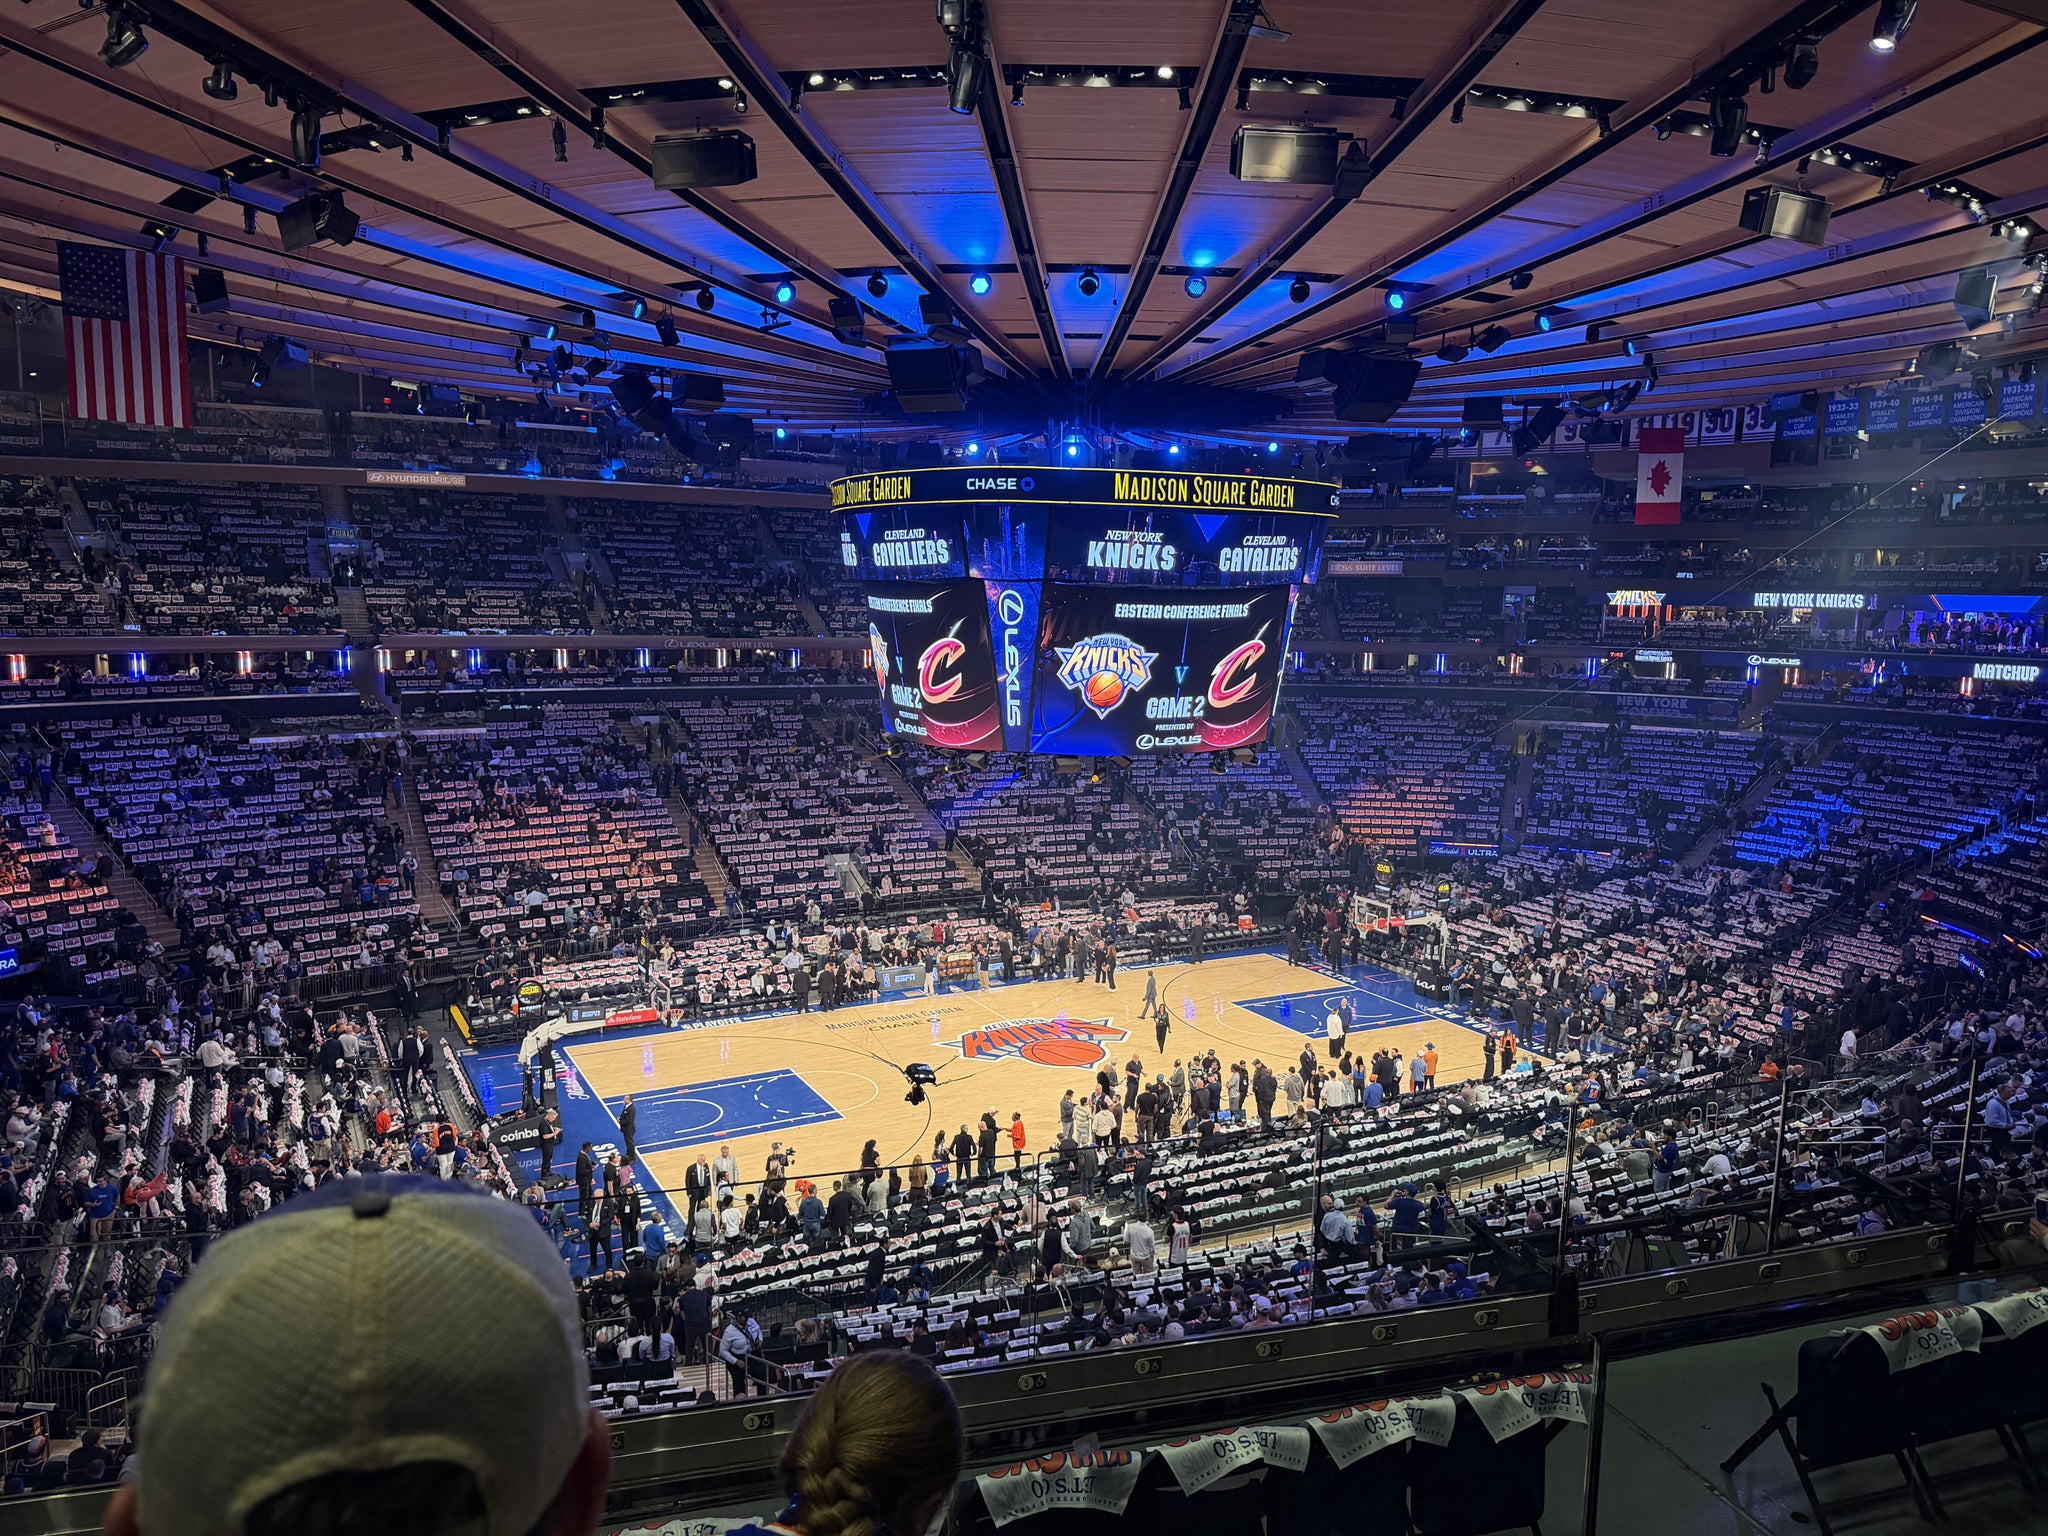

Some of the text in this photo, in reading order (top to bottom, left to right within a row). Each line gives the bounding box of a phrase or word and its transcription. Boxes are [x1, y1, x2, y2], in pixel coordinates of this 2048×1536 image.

[2003, 384, 2035, 394] 1931-32
[1869, 399, 1899, 409] 1939-40
[1912, 394, 1943, 405] 1993-94
[1952, 400, 1984, 409] AMERICAN
[2002, 395, 2033, 404] AMERICAN
[1828, 402, 1859, 412] 1932-33
[1913, 405, 1939, 413] STANLEY
[1955, 407, 1980, 415] DIVISION
[2004, 402, 2029, 410] DIVISION
[1788, 416, 1812, 424] STANLEY
[1830, 412, 1856, 420] STANLEY
[1950, 414, 1984, 423] CHAMPIONS
[1866, 422, 1898, 430] CHAMPIONS
[1908, 418, 1942, 427] CHAMPIONS
[1783, 429, 1815, 437] CHAMPIONS
[1824, 425, 1857, 434] CHAMPIONS
[430, 475, 464, 485] BRIDGE
[966, 478, 1017, 490] CHASE
[846, 479, 871, 504] SQUARE
[873, 475, 911, 500] GARDEN
[1114, 473, 1295, 508] MADISON SQUARE GARDEN
[884, 529, 925, 540] CLEVELAND
[1105, 530, 1164, 543] NEW YORK
[1243, 535, 1286, 546] CLEVELAND
[873, 539, 949, 567] CAVALIERS
[1087, 541, 1176, 570] KNICKS
[1219, 547, 1298, 572] CAVALIERS
[1615, 590, 1659, 605] KNICKS
[1754, 592, 1864, 608] NEW YORK KNICKS
[1115, 603, 1249, 618] EASTERN CONFERENCE FINALS
[1093, 637, 1128, 648] NEW YORK
[1063, 645, 1147, 676] KNICKS
[1004, 628, 1021, 727] LEXUS
[1174, 665, 1189, 685] V
[1973, 663, 2040, 682] MATCHUP
[891, 684, 922, 709] GAME 2
[1617, 695, 1688, 709] NEW YORK
[1146, 696, 1206, 719] GAME 2
[902, 723, 928, 736] LEXUS
[1155, 723, 1182, 731] PRESENTED
[1155, 735, 1202, 746] LEXUS
[1468, 849, 1499, 857] ULTRA
[894, 973, 916, 982] ESPN
[692, 1017, 742, 1030] PLAYOFFS
[825, 1006, 964, 1031] MADISON SQUARE GARDEN
[869, 1019, 929, 1032] CHASE
[964, 1019, 1127, 1058] KNICKS
[1918, 1333, 1939, 1350] GO
[1364, 1416, 1387, 1434] GO
[1213, 1438, 1237, 1458] GO
